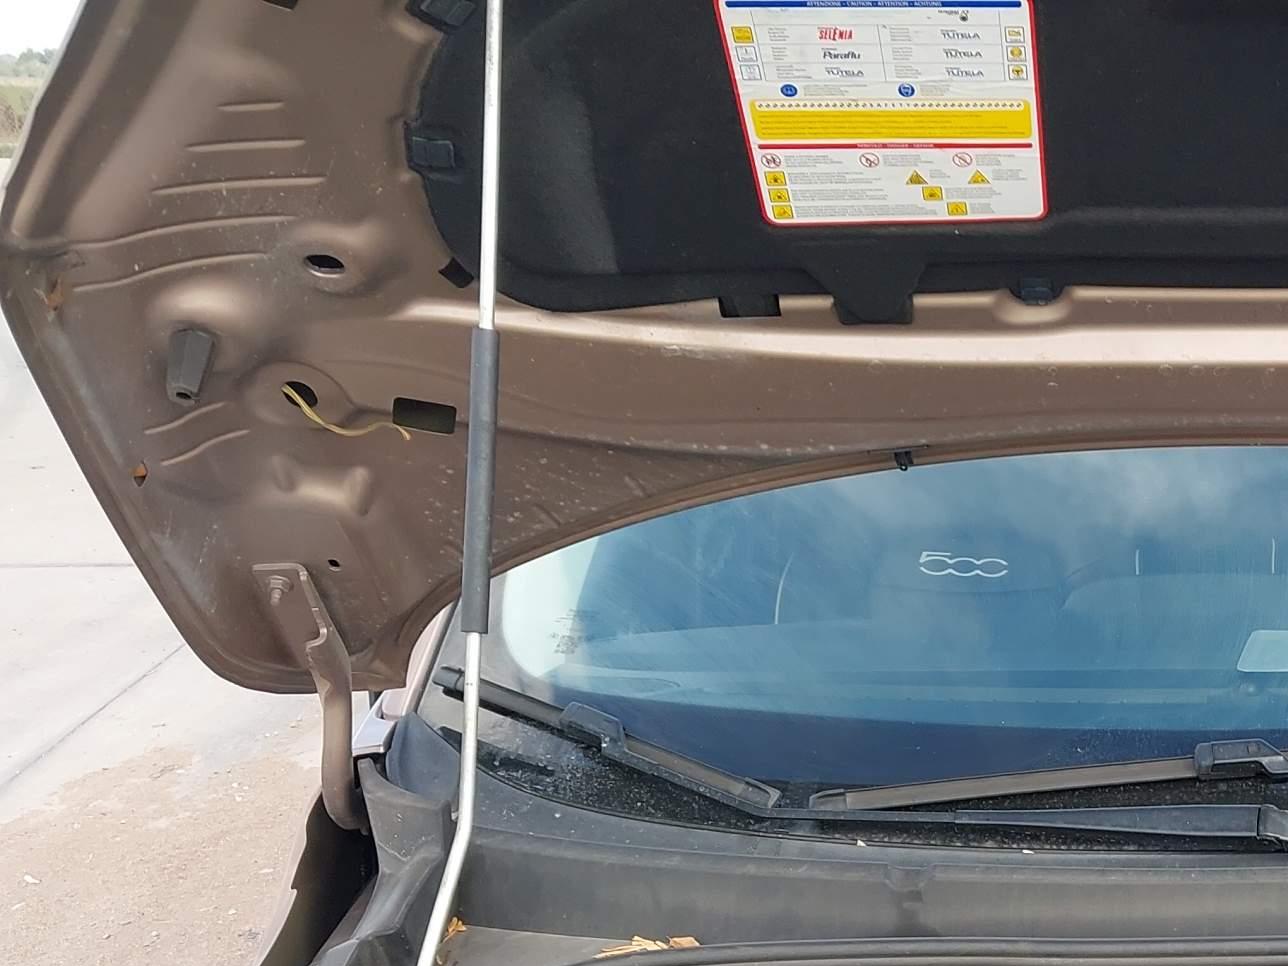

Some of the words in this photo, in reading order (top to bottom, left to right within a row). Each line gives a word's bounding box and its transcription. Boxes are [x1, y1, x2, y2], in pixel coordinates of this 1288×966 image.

[942, 31, 981, 40] TUTELA
[823, 50, 861, 60] Paraflu
[944, 50, 983, 59] TUTELA
[826, 69, 864, 78] TUTELA
[946, 69, 985, 78] TUTELA
[918, 551, 1009, 578] 500
